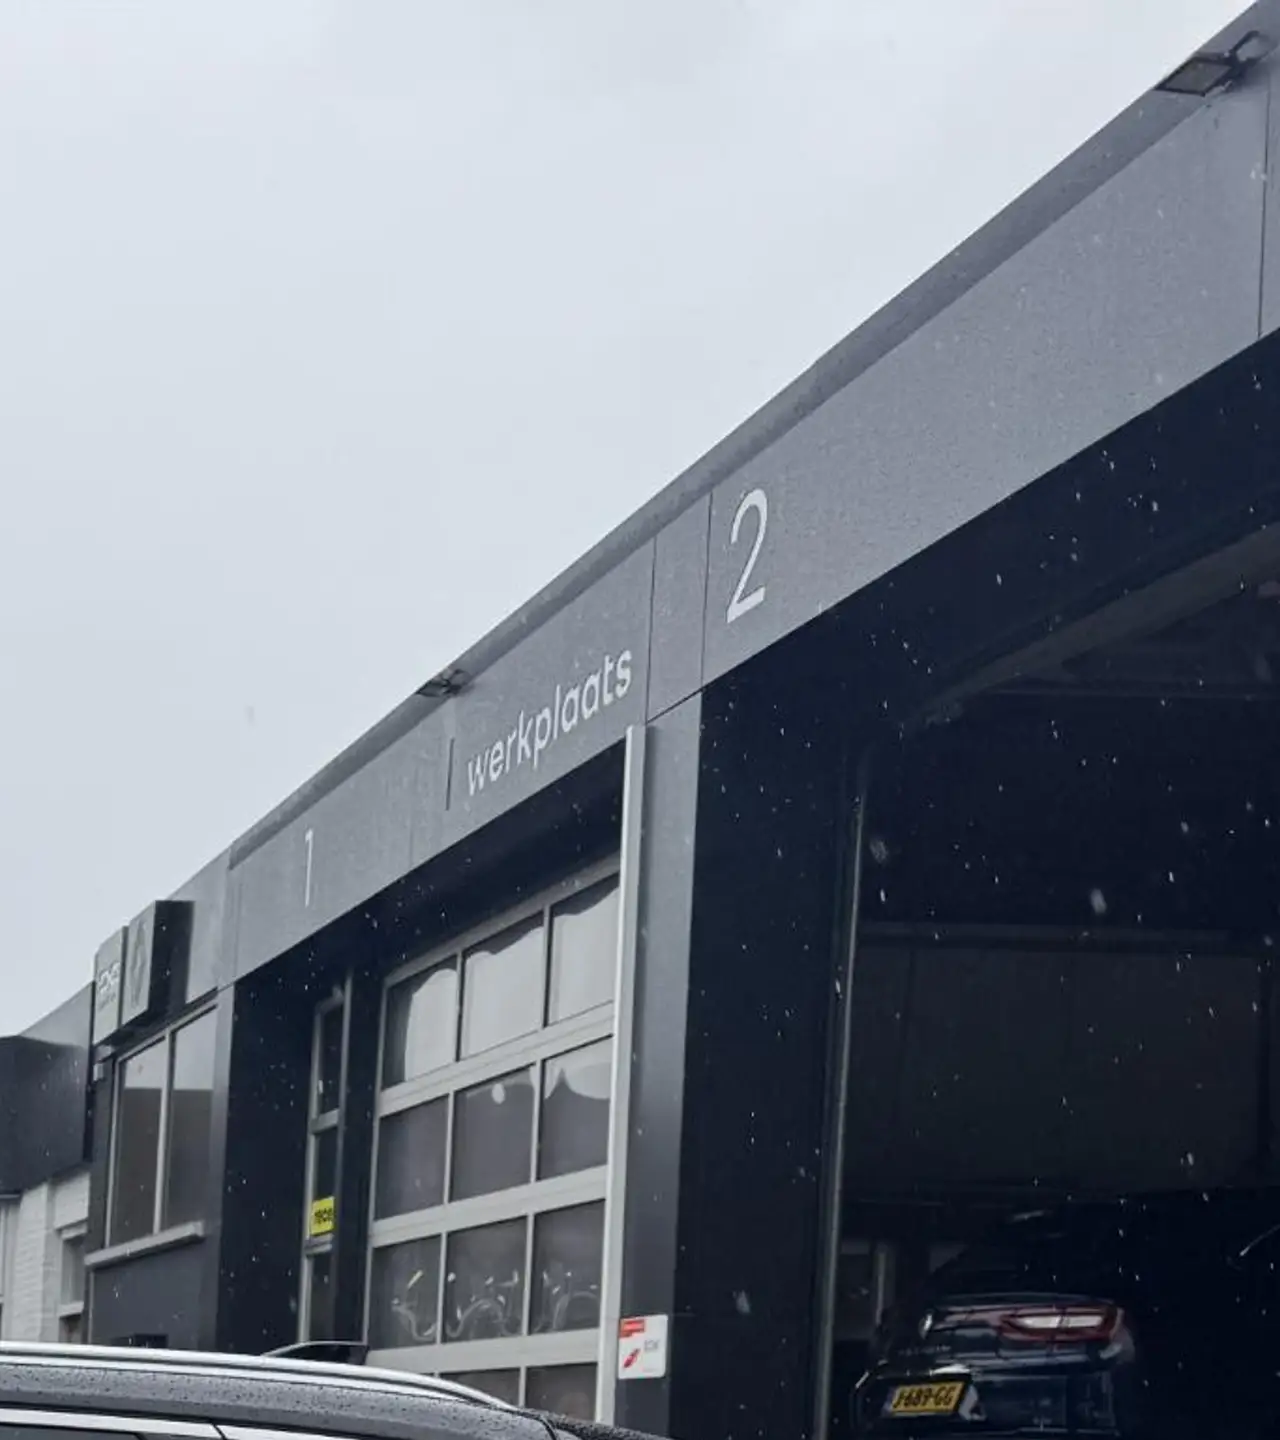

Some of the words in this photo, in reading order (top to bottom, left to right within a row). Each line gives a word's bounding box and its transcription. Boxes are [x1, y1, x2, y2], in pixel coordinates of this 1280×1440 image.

[726, 489, 768, 624] 2
[467, 650, 632, 797] werkplaats
[304, 828, 314, 908] 1
